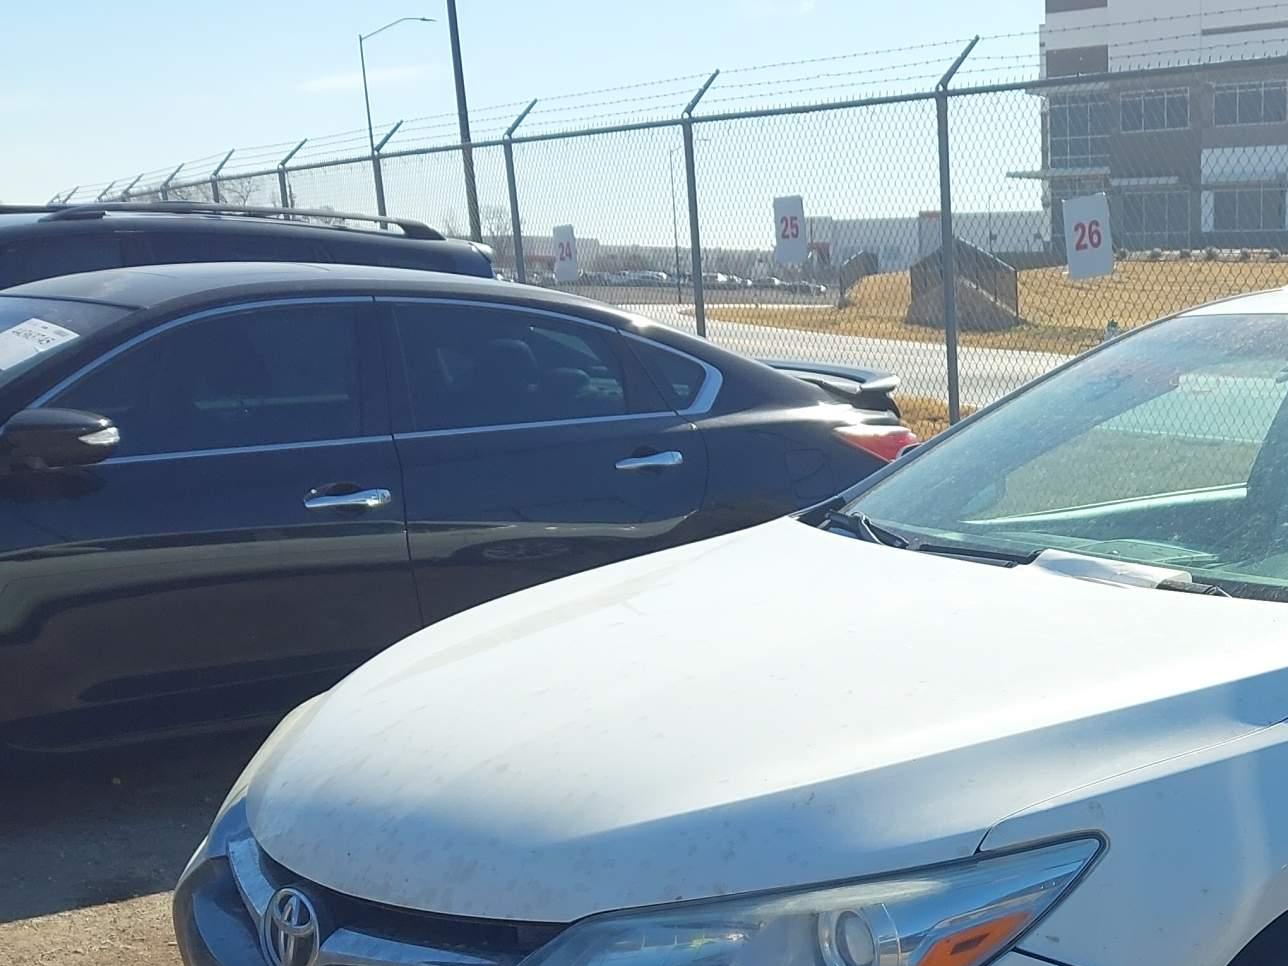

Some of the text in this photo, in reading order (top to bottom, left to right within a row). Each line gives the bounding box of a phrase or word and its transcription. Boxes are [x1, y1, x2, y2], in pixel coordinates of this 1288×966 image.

[780, 215, 799, 239] 25
[1074, 219, 1102, 251] 26
[559, 241, 572, 261] 24
